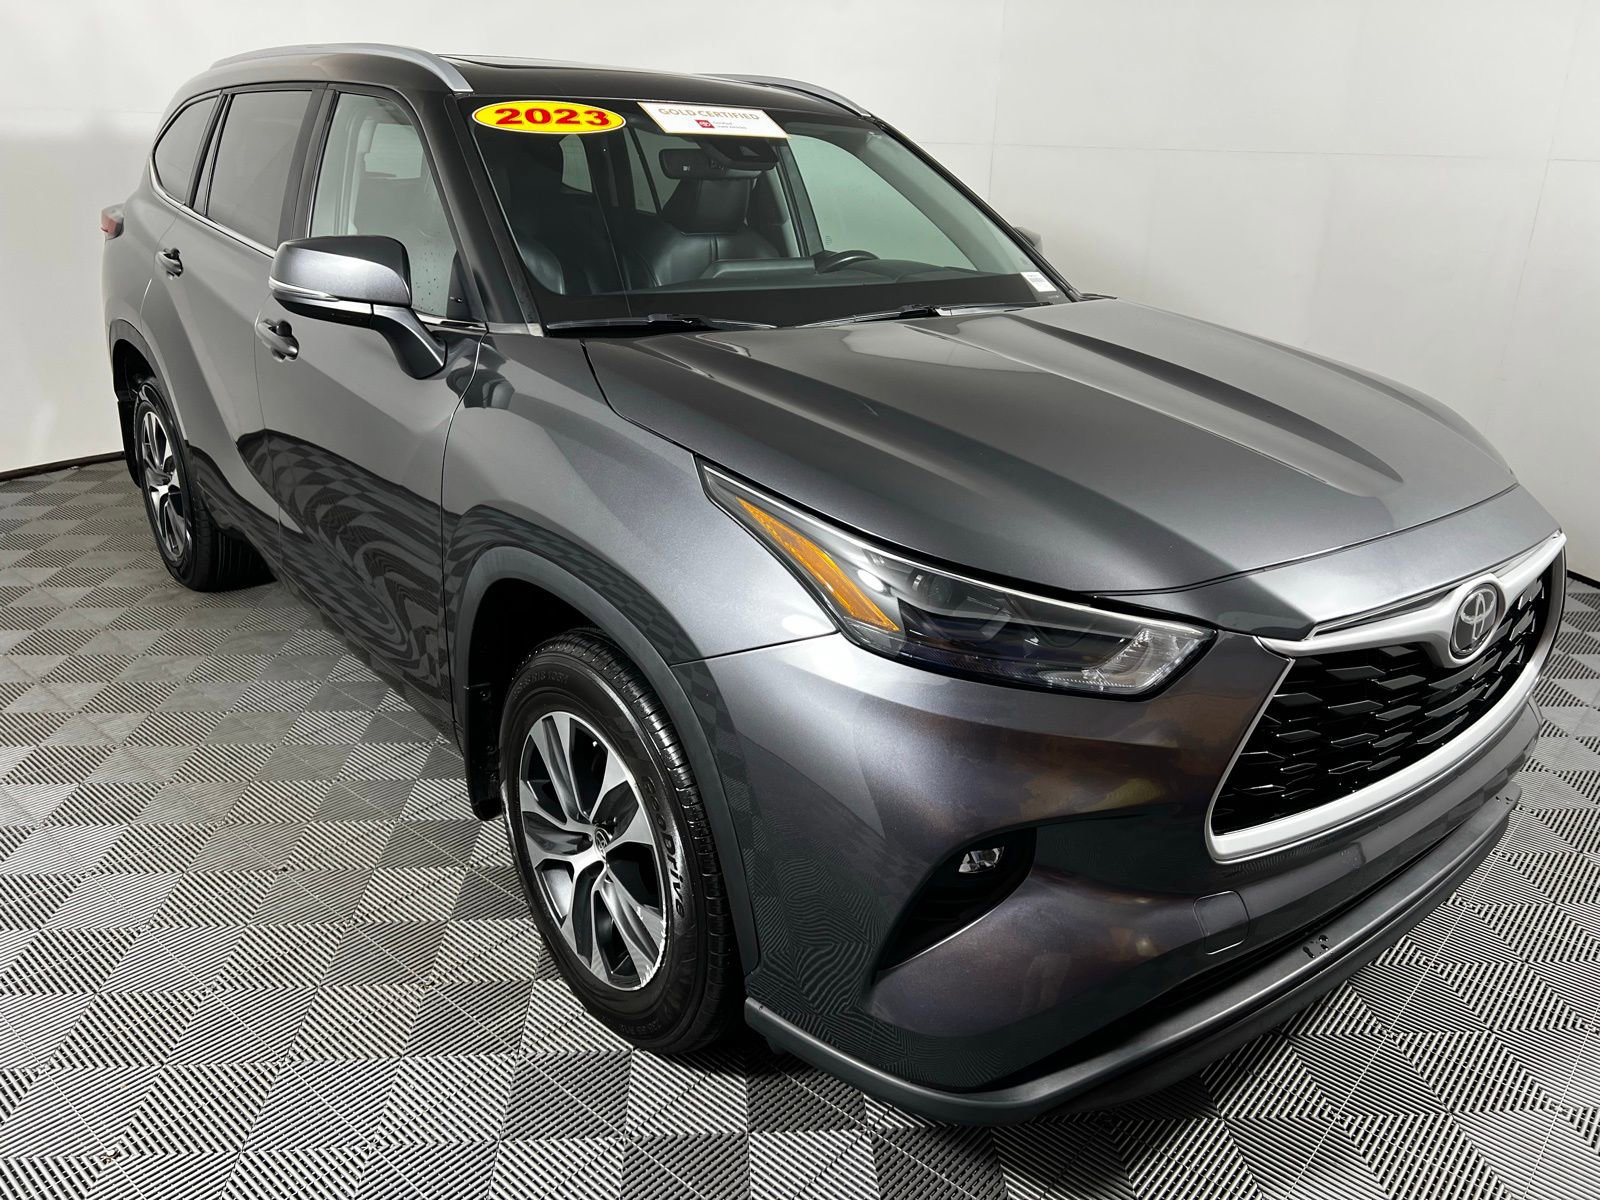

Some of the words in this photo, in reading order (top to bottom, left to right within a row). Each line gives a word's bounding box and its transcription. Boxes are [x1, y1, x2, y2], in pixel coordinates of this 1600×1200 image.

[495, 108, 609, 126] 2023
[658, 108, 695, 117] GOLD
[697, 110, 760, 120] CERTIFIED
